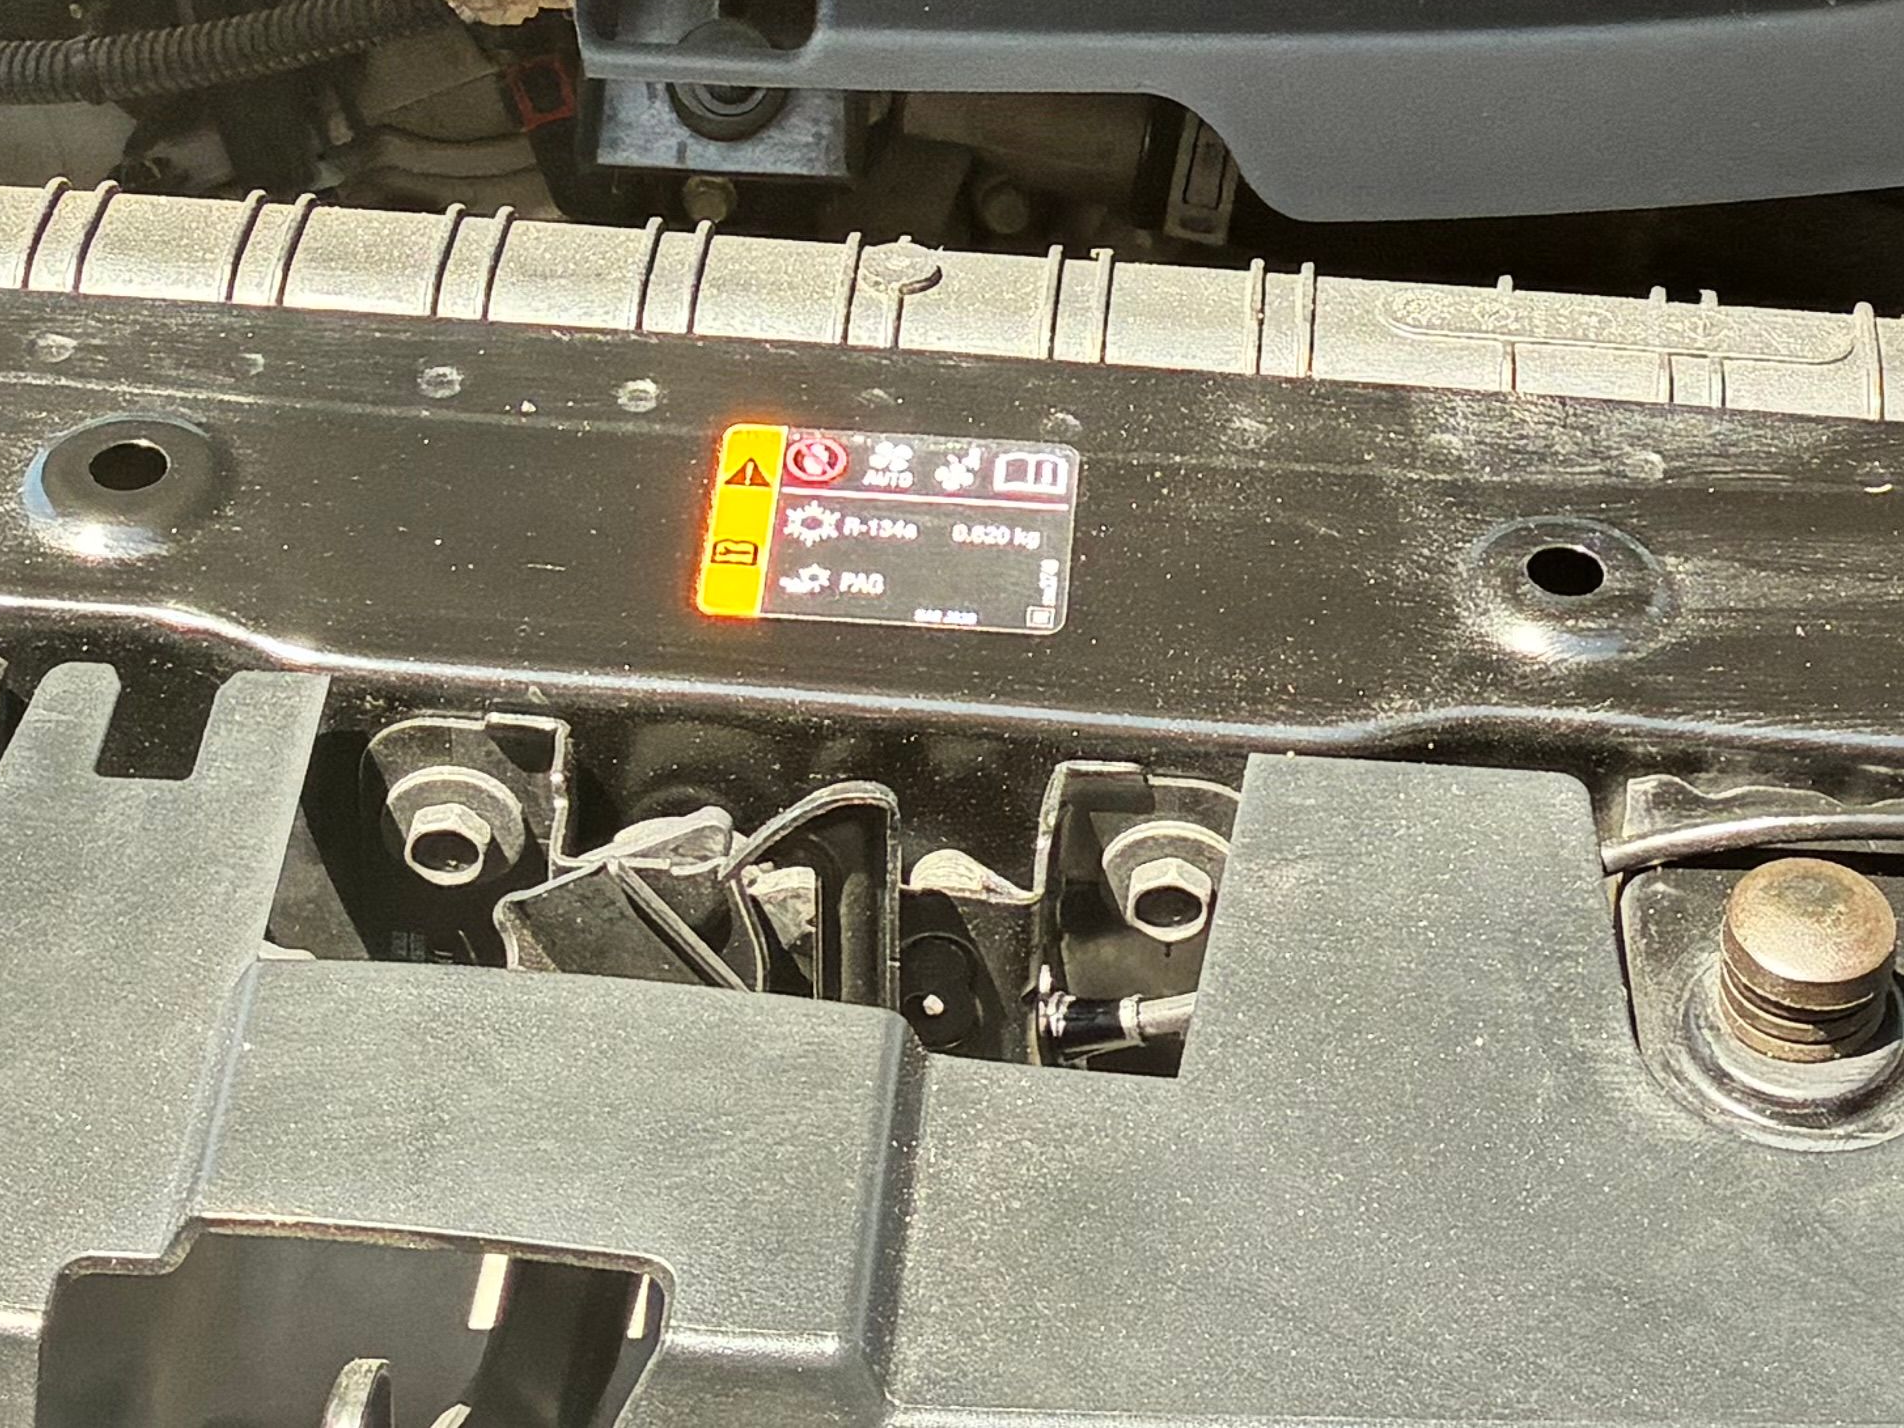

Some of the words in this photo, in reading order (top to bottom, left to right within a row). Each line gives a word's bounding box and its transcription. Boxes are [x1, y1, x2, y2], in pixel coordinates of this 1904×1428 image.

[862, 469, 914, 488] AUTO
[842, 517, 919, 541] R-134a
[839, 572, 885, 594] PAG
